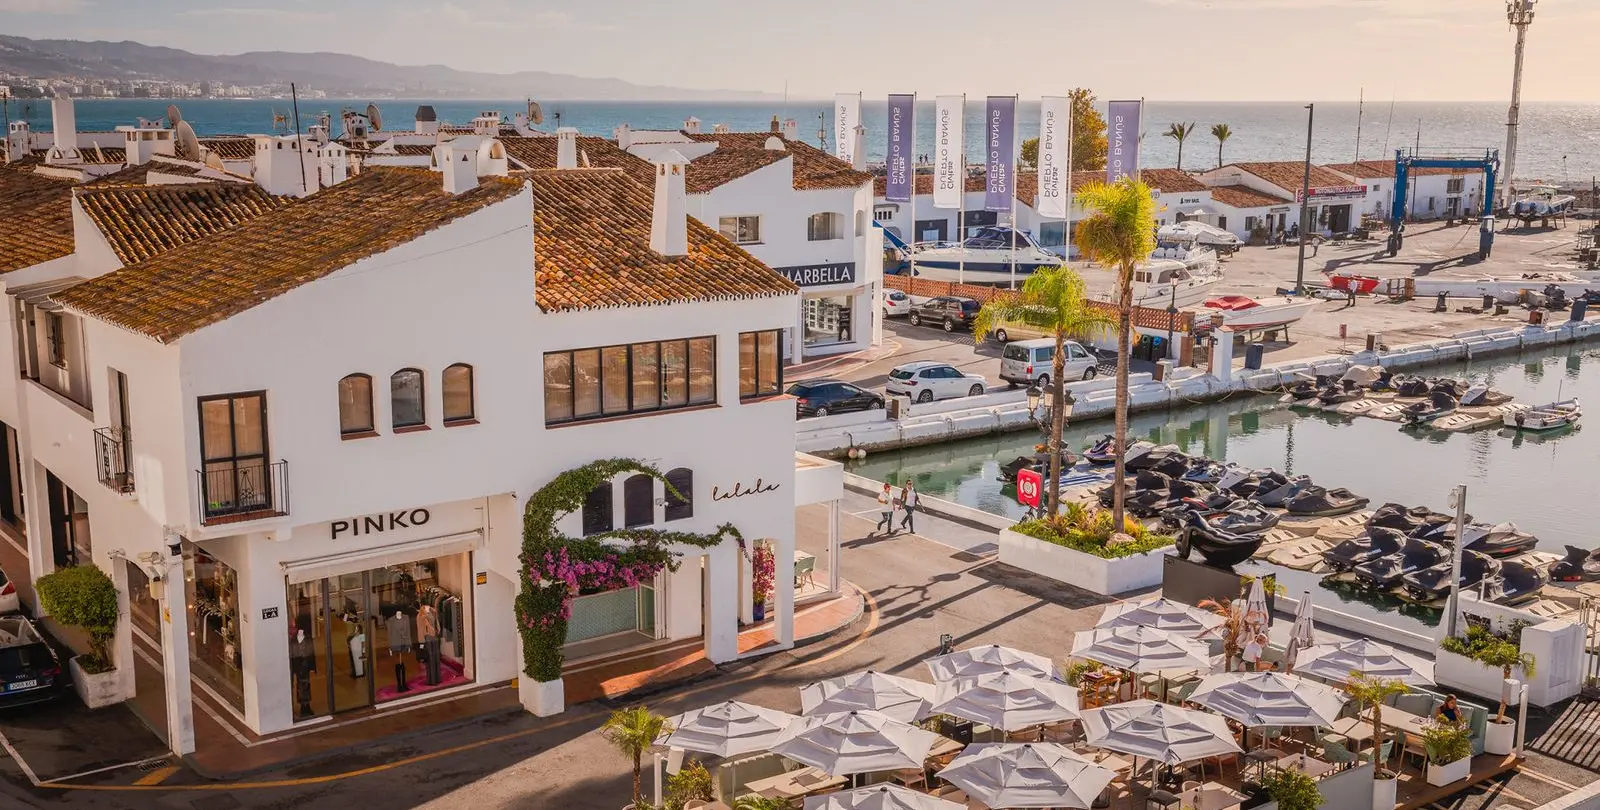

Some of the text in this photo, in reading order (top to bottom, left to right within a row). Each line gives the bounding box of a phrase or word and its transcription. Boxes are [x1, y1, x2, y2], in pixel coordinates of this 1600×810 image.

[780, 266, 851, 285] MARBELLA
[712, 478, 780, 501] lalala
[331, 508, 430, 540] PINKO
